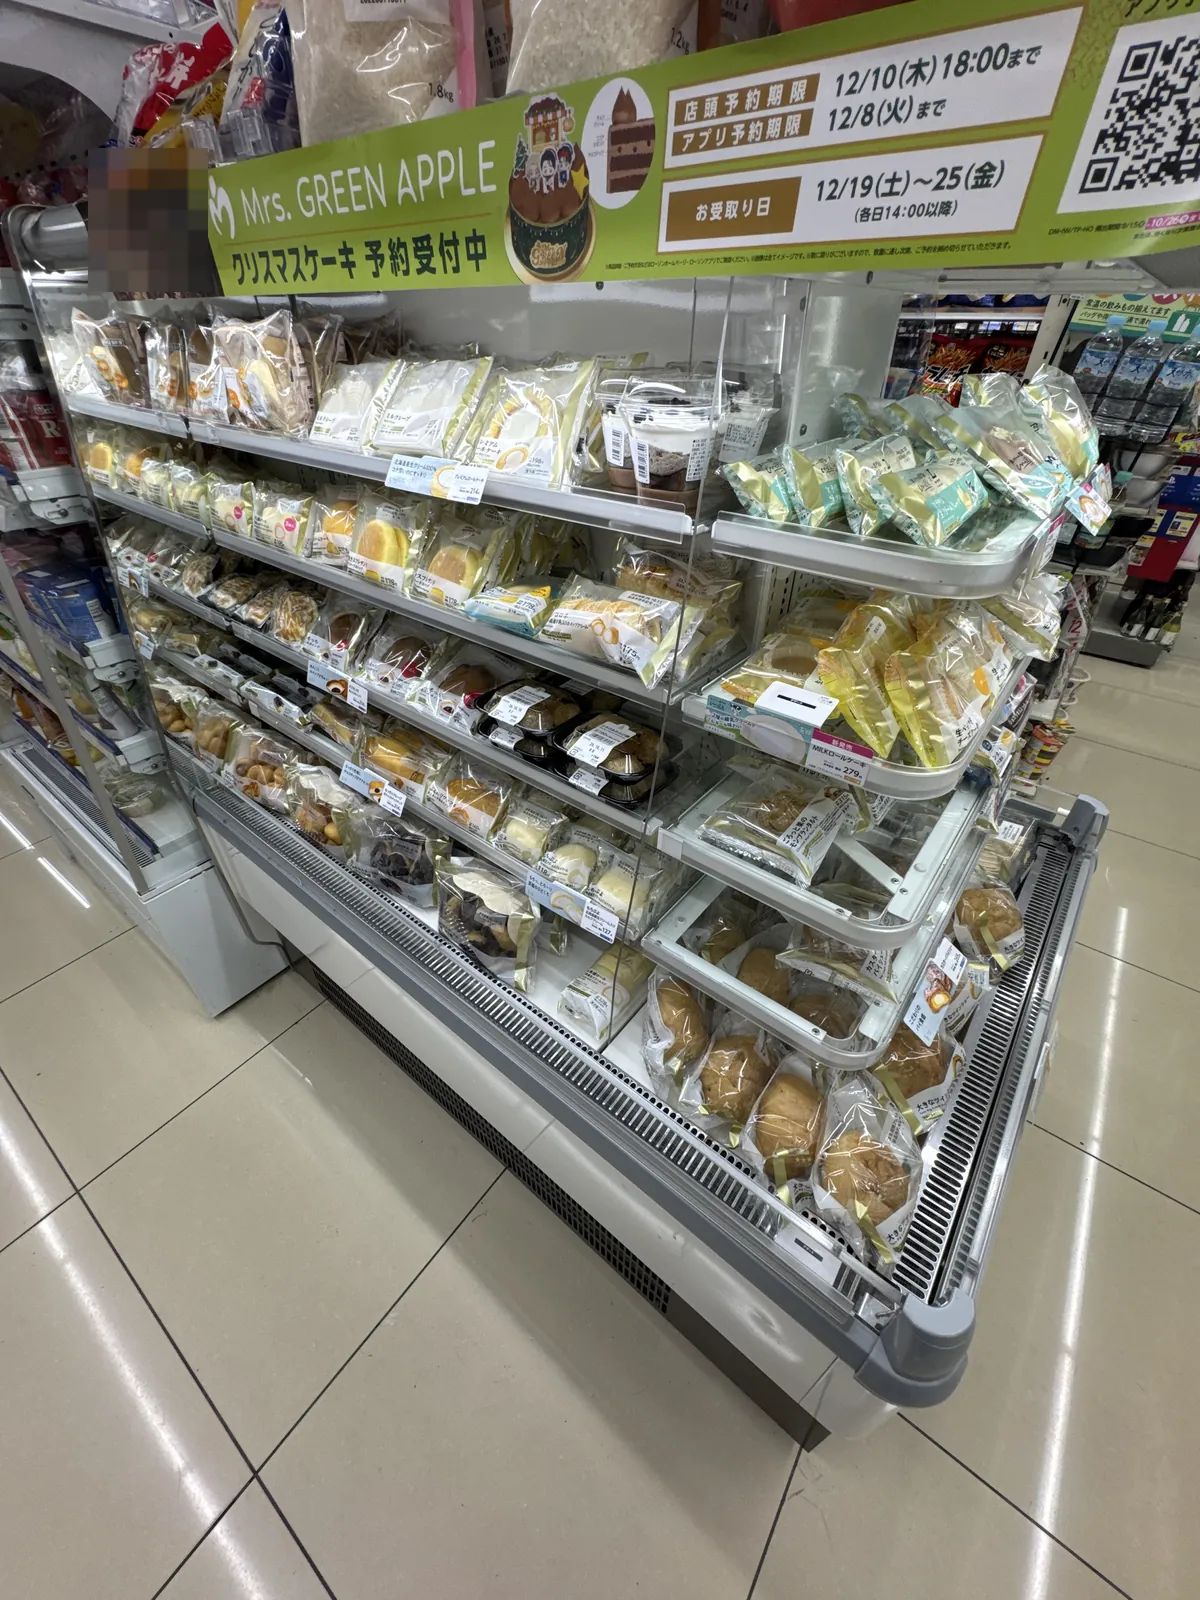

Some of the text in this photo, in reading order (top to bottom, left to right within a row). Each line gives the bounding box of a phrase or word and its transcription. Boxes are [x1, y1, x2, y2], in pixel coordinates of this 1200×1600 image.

[683, 78, 808, 123] 店頭予約期限
[828, 97, 947, 131] 12/8(火)まで
[682, 114, 802, 151] アプリ予約期限
[240, 139, 498, 227] Mrs. GREEN APPLE
[695, 196, 772, 223] お受取り日
[854, 199, 959, 224] (各日14:00以降)
[231, 227, 488, 285] クリスマスケーキ 予約受付中
[1166, 366, 1194, 379] 天然水
[812, 745, 867, 768] MILKロールケーキ
[831, 739, 853, 752] 新発売
[943, 996, 970, 1023] きなツインシュー
